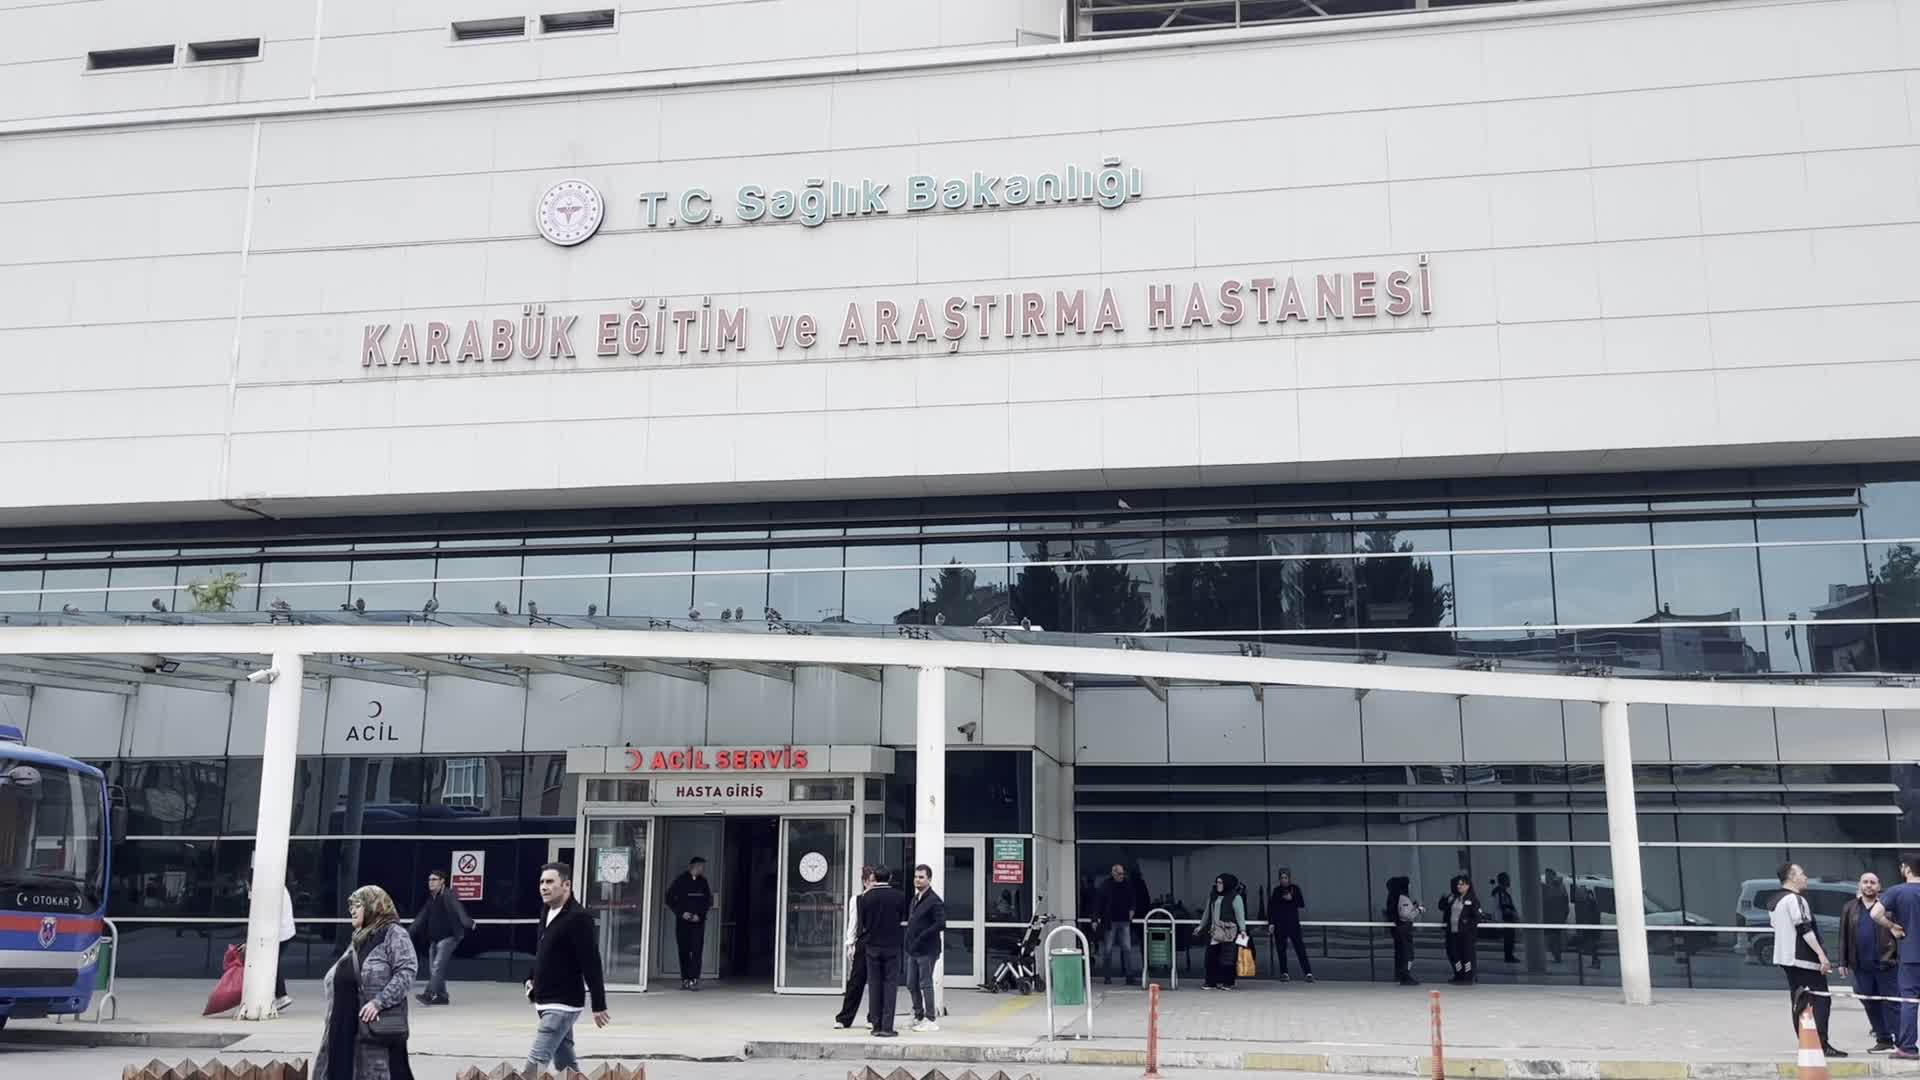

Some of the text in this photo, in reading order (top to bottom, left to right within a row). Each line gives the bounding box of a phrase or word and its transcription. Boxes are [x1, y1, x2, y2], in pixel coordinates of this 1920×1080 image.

[639, 187, 723, 226] T.C.
[735, 177, 890, 227] Sağlık
[905, 155, 1143, 212] Bakanlığı
[360, 253, 1433, 367] KARABÜK EĞİTİM ve ARAŞTIRMA HASTANESİ
[345, 721, 400, 742] ACİL
[651, 743, 809, 770] ACİL SERVİS
[675, 782, 764, 799] HASTA GİRİŞ
[32, 895, 70, 906] OTOKAR
